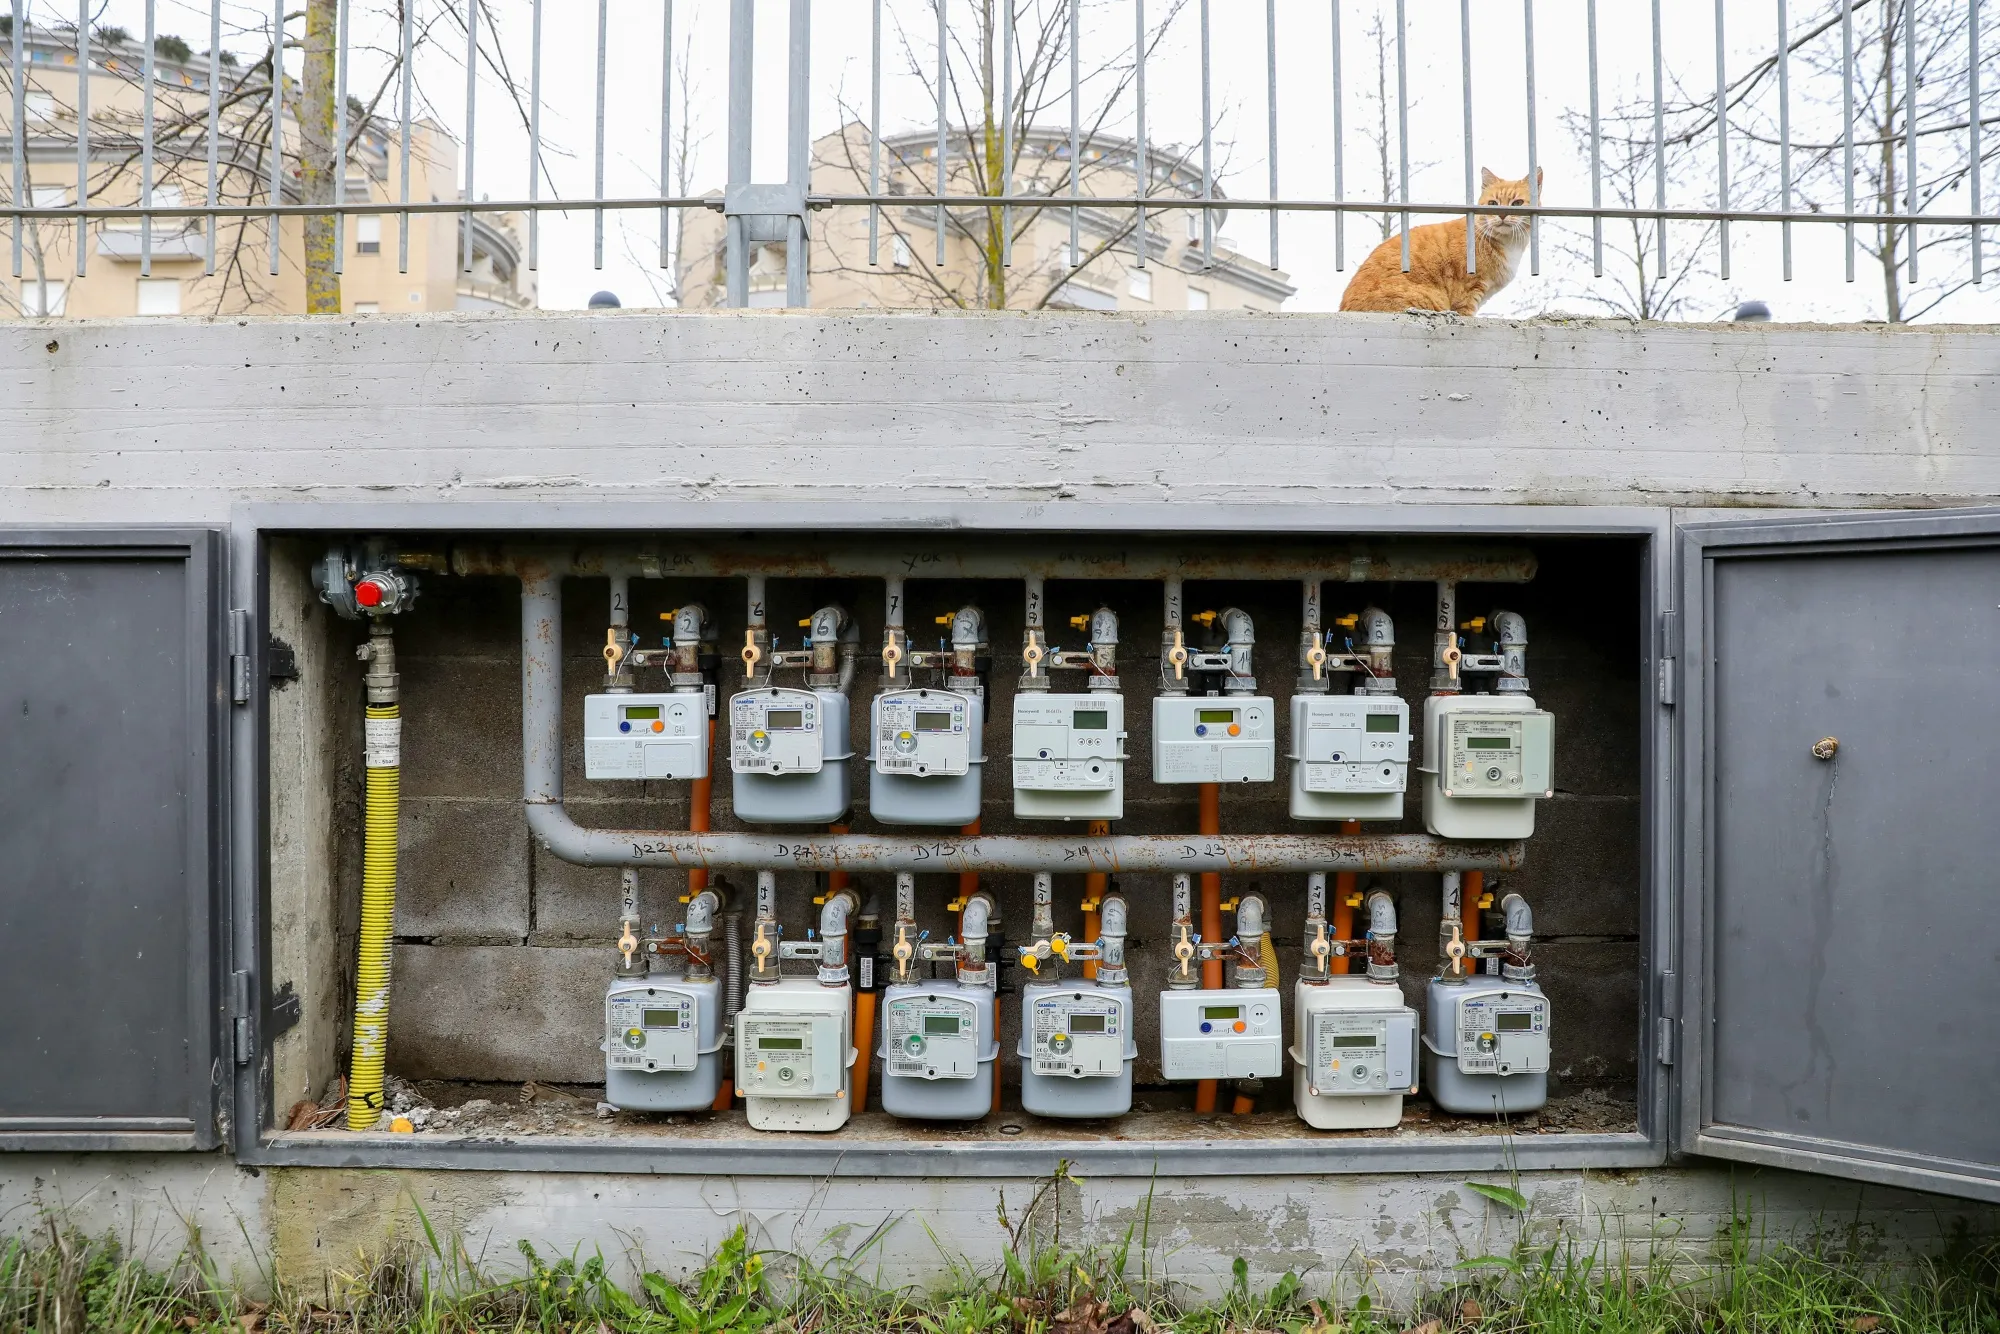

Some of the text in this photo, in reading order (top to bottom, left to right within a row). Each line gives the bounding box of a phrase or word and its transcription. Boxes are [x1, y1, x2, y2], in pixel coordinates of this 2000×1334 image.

[613, 592, 625, 611] 2
[753, 602, 764, 617] 6
[889, 595, 899, 615] 7
[683, 619, 698, 634] 2
[816, 616, 829, 637] 6
